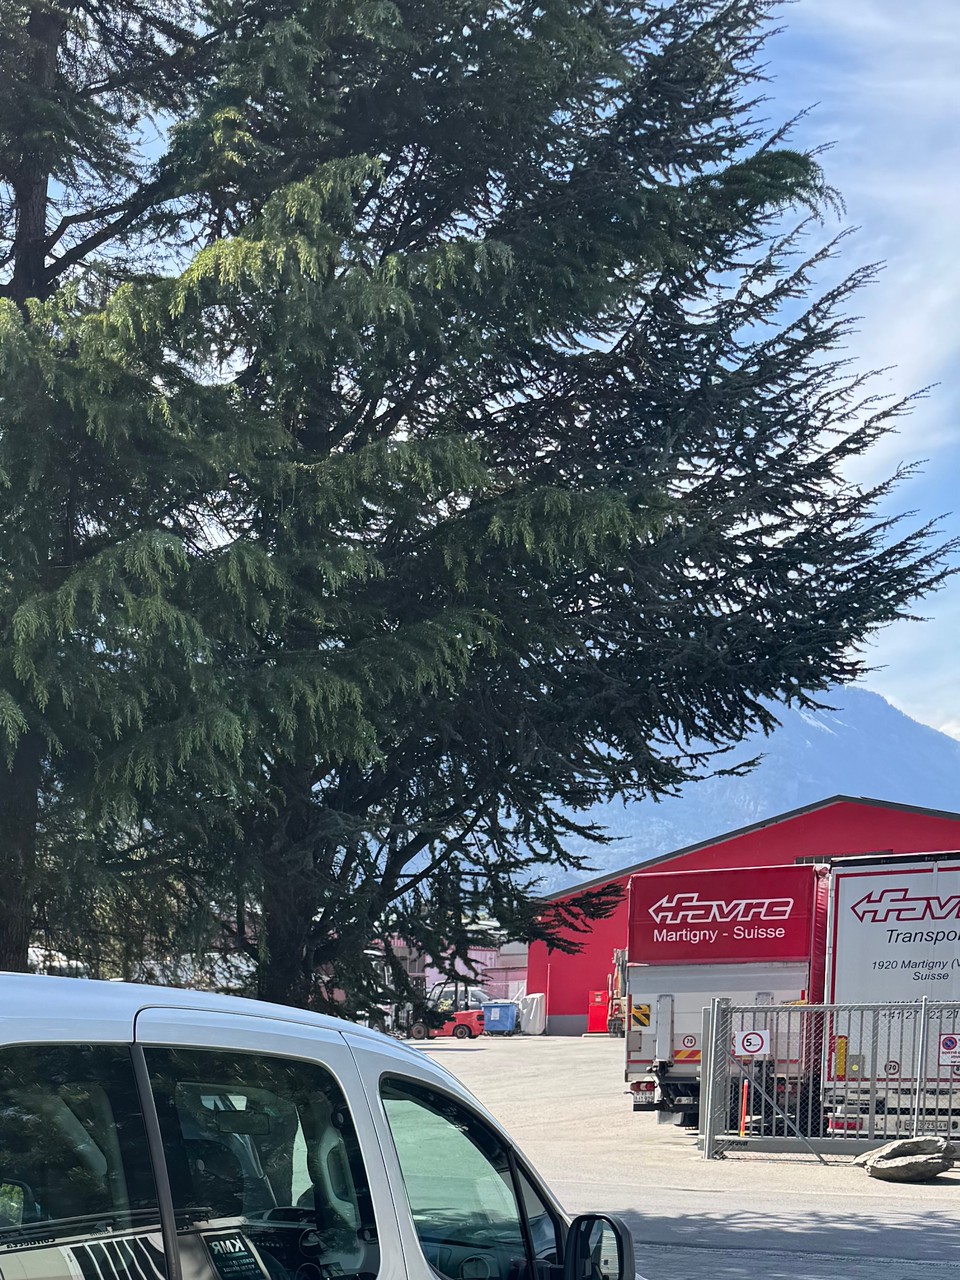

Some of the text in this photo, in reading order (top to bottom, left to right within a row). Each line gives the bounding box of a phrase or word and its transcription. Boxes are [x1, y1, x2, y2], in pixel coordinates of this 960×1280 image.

[653, 928, 718, 943] Martigny
[733, 925, 786, 939] Suisse
[872, 960, 898, 970] 1920
[901, 959, 948, 970] Martigny
[912, 971, 950, 981] Suisse
[745, 1038, 752, 1047] 5
